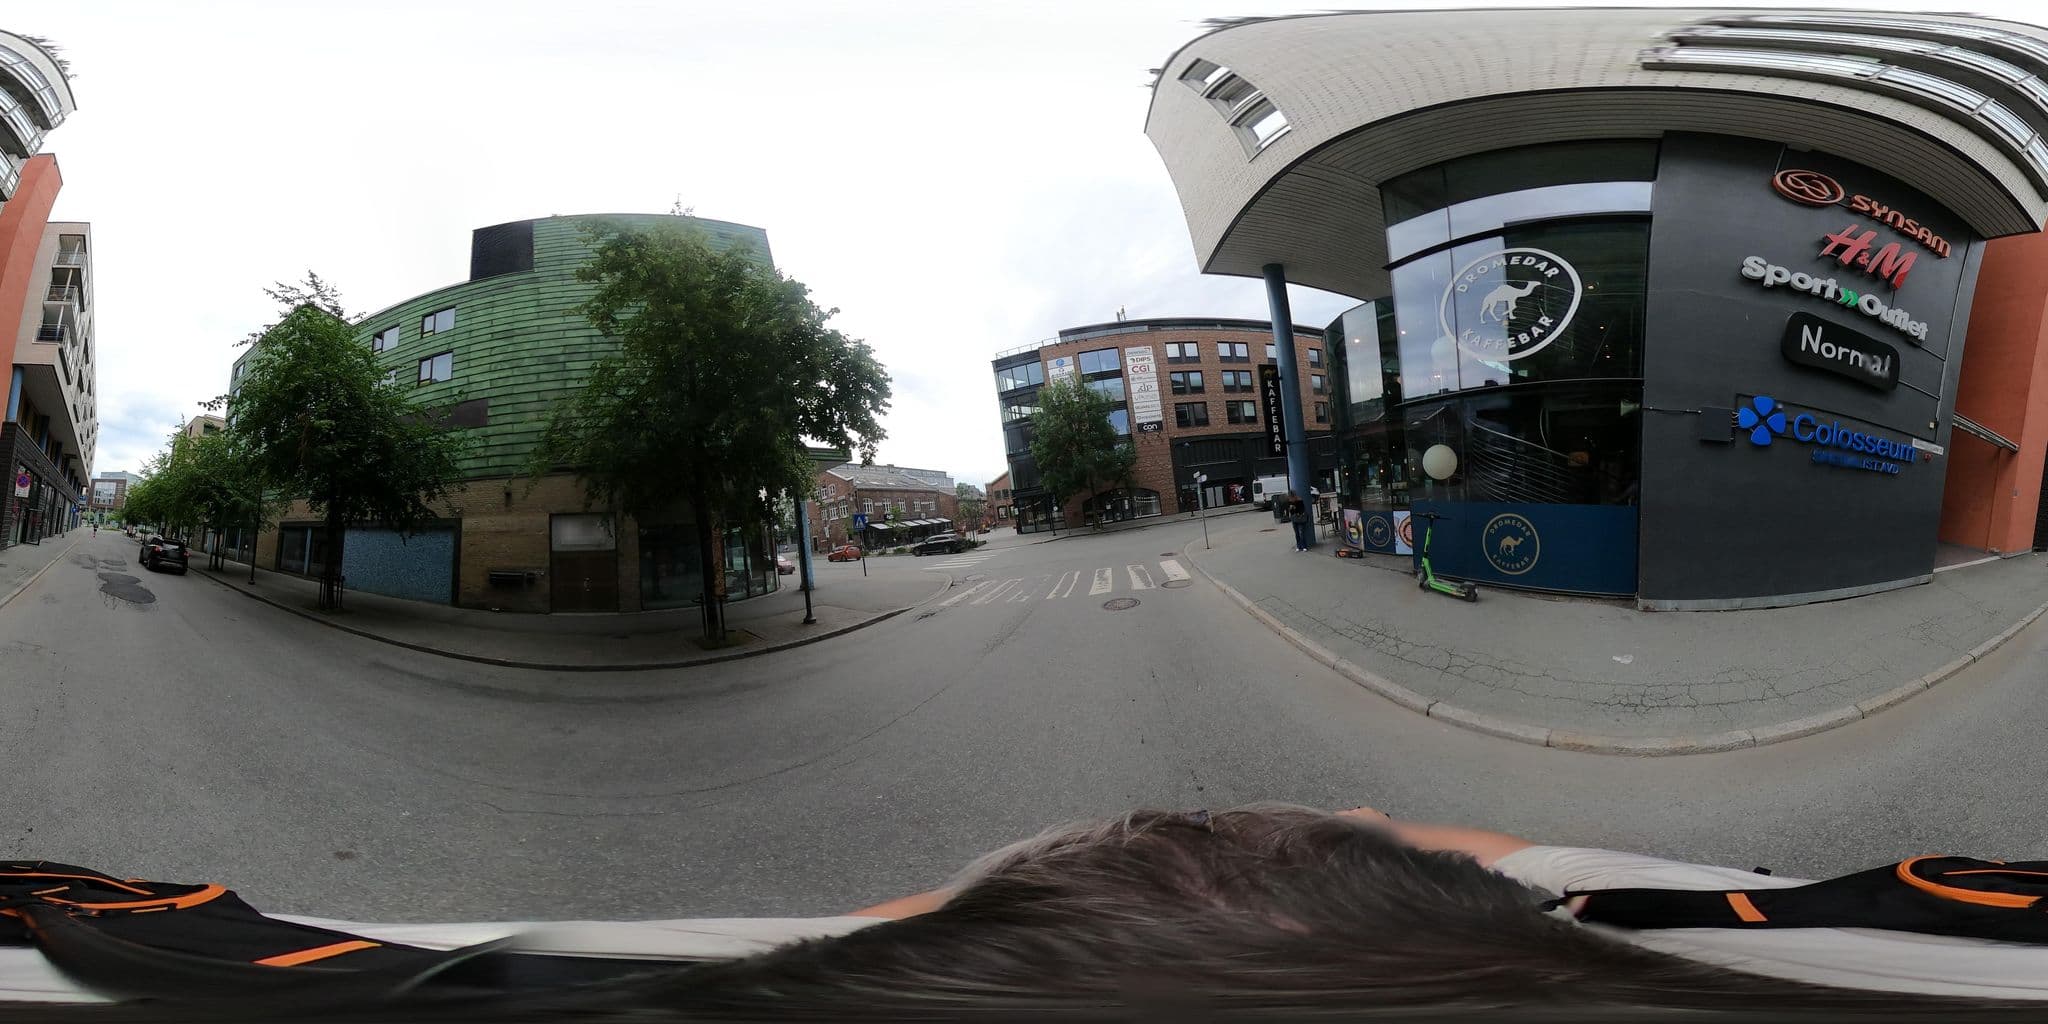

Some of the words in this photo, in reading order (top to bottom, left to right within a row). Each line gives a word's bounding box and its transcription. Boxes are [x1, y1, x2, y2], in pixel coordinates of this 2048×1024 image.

[1850, 194, 1952, 259] SYNSAM
[1456, 255, 1561, 293] DROMEDAR
[1819, 223, 1918, 290] H&M
[1462, 316, 1554, 352] KAFFEBAR
[1857, 293, 1929, 341] Outlet
[1131, 364, 1150, 373] CGI
[1801, 323, 1891, 377] Normal
[1267, 380, 1281, 452] KAFFEBAR
[1793, 412, 1916, 464] Colosseum
